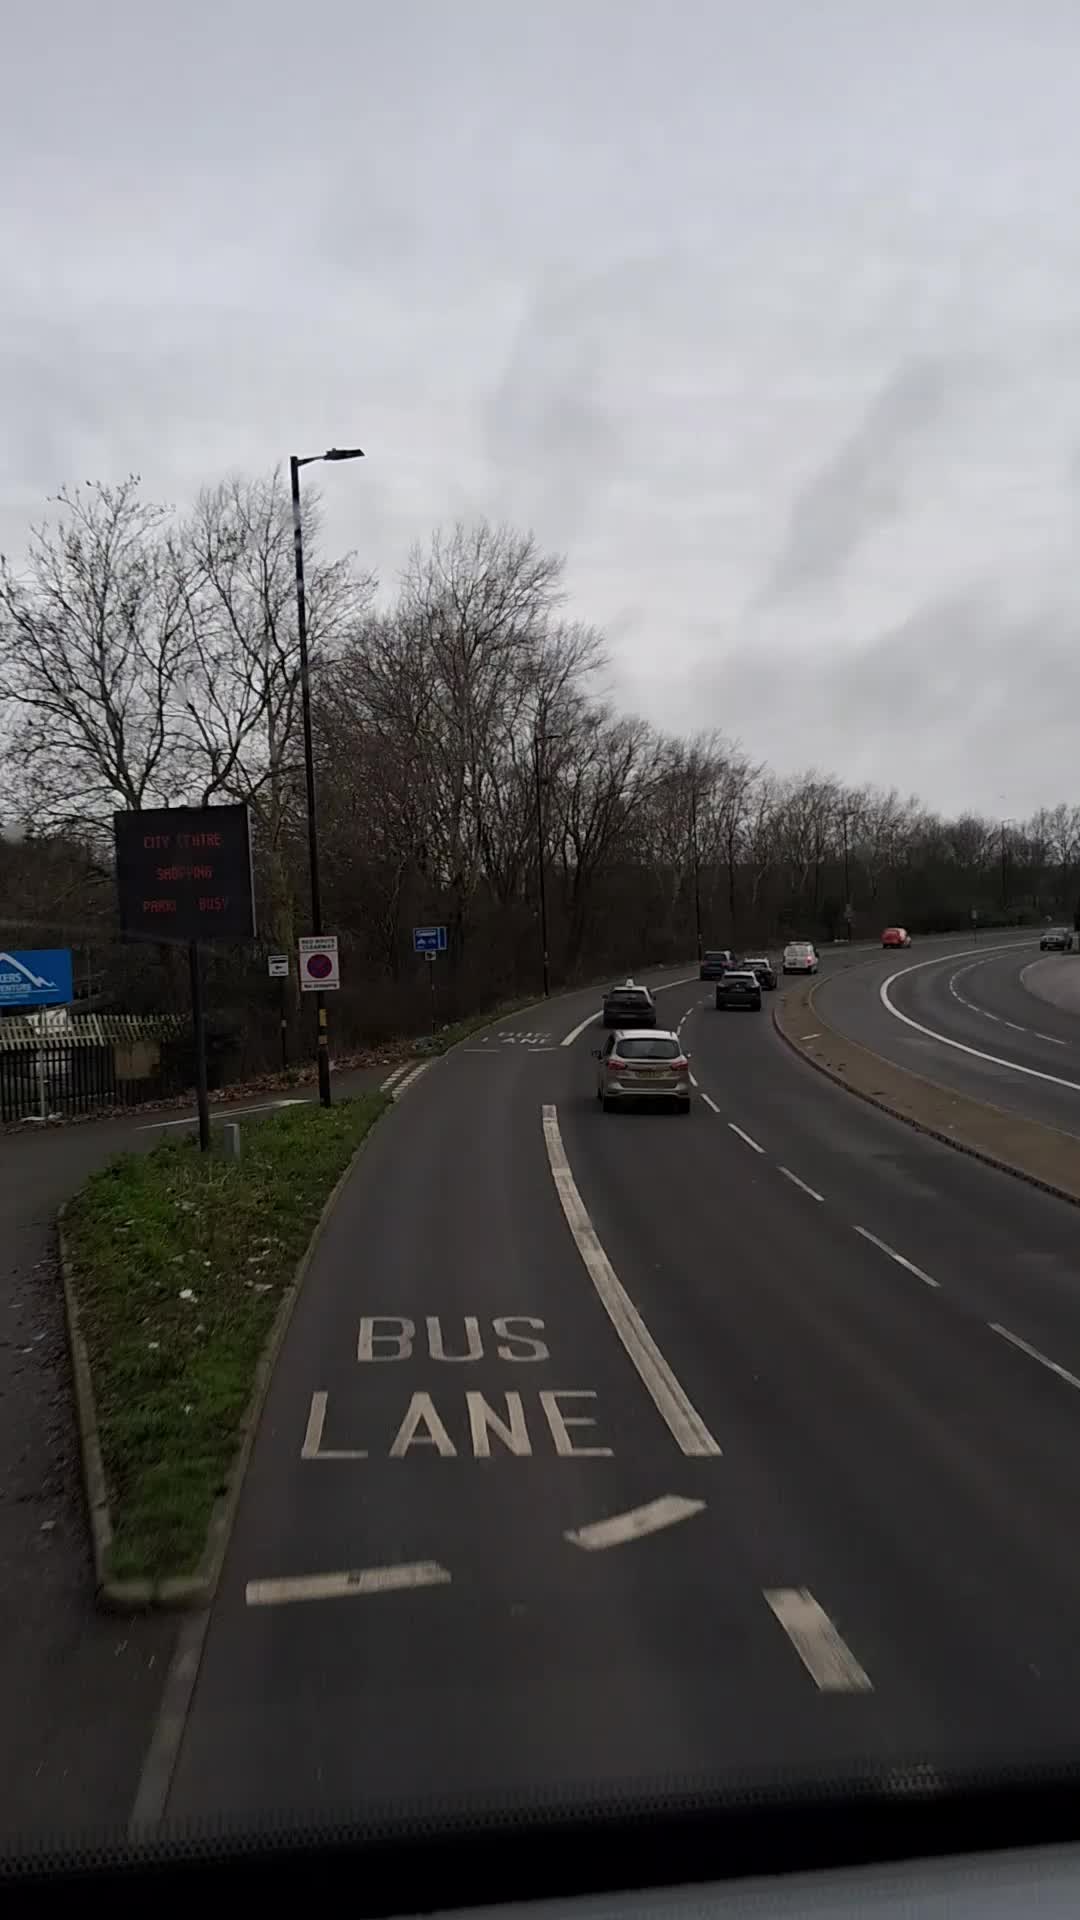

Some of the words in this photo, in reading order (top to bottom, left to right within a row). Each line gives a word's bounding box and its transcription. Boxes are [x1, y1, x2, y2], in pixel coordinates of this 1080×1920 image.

[143, 836, 170, 848] CITY
[357, 1316, 550, 1362] BUS
[301, 1391, 615, 1460] LANE
